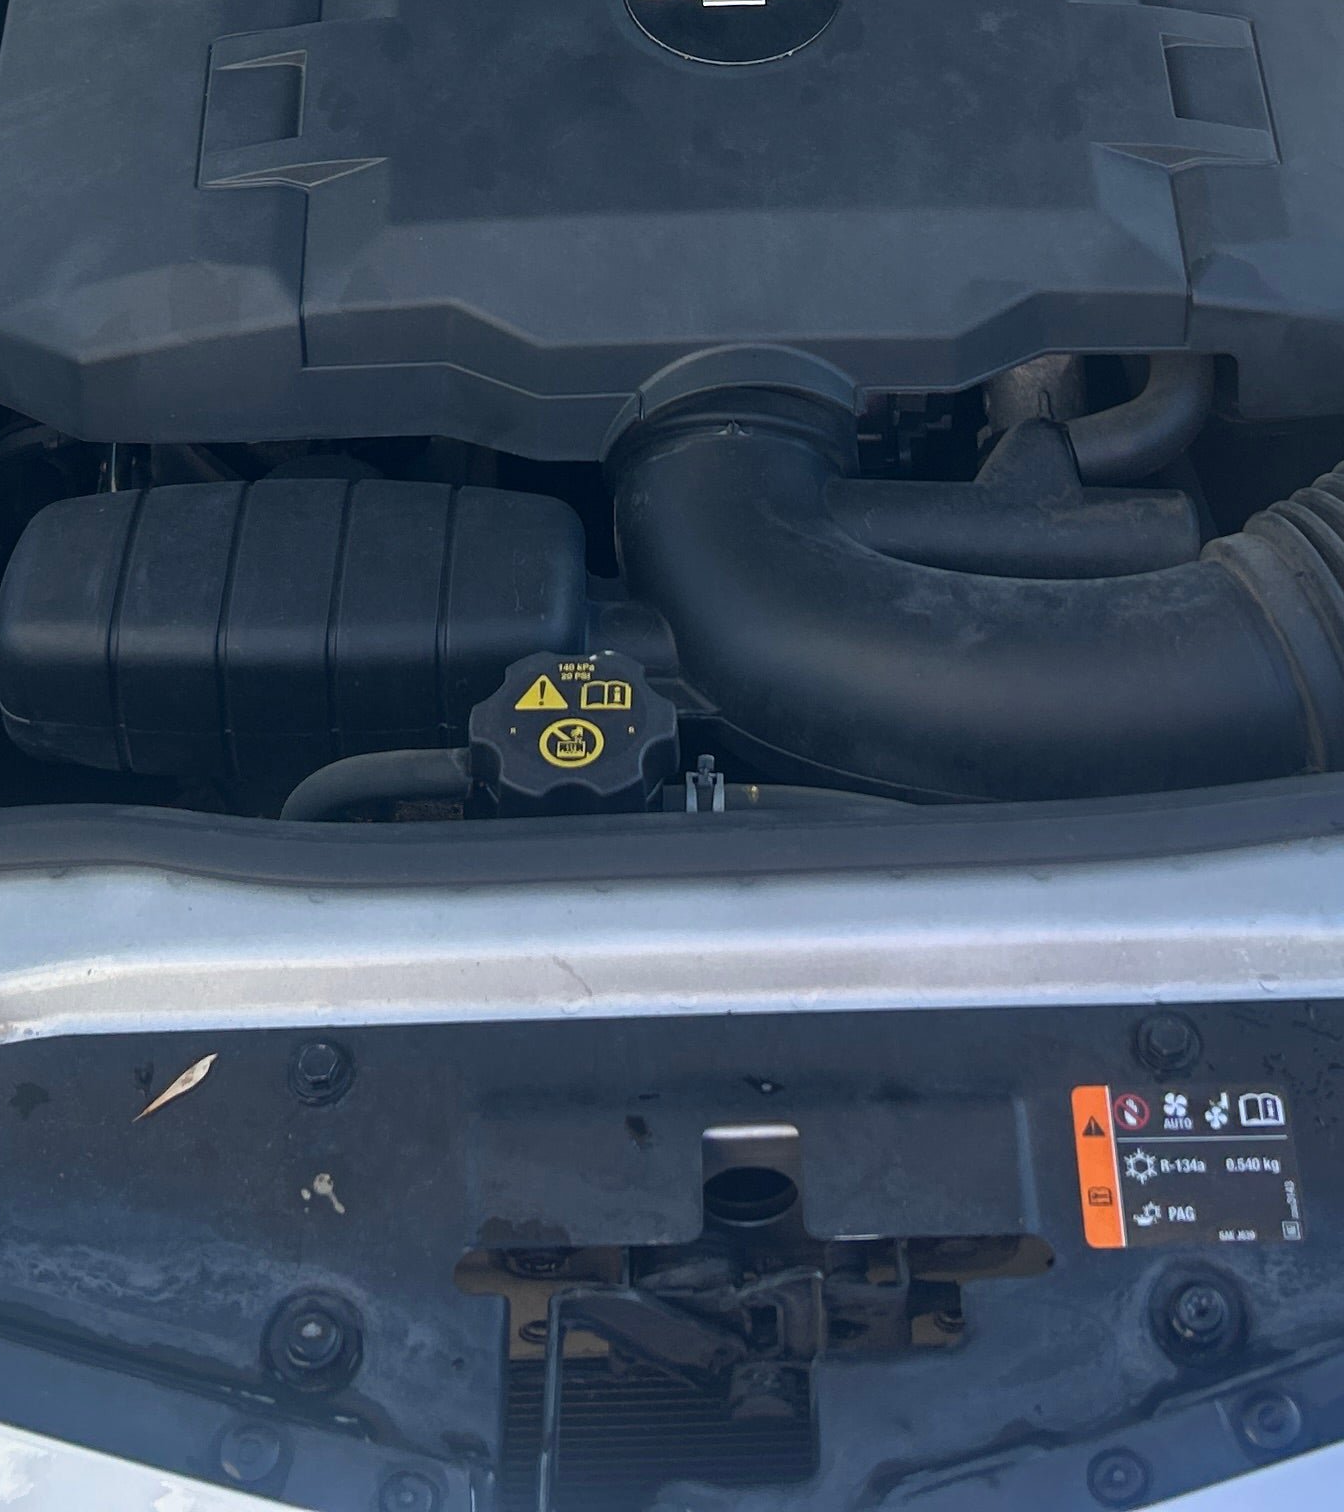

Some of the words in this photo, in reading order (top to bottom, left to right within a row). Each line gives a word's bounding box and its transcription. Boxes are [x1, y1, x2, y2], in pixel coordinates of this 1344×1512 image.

[558, 663, 575, 672] 140
[1164, 1117, 1192, 1130] AUTO
[1160, 1157, 1205, 1173] R-134a
[1263, 1157, 1281, 1174] kg
[1168, 1206, 1196, 1222] PAG
